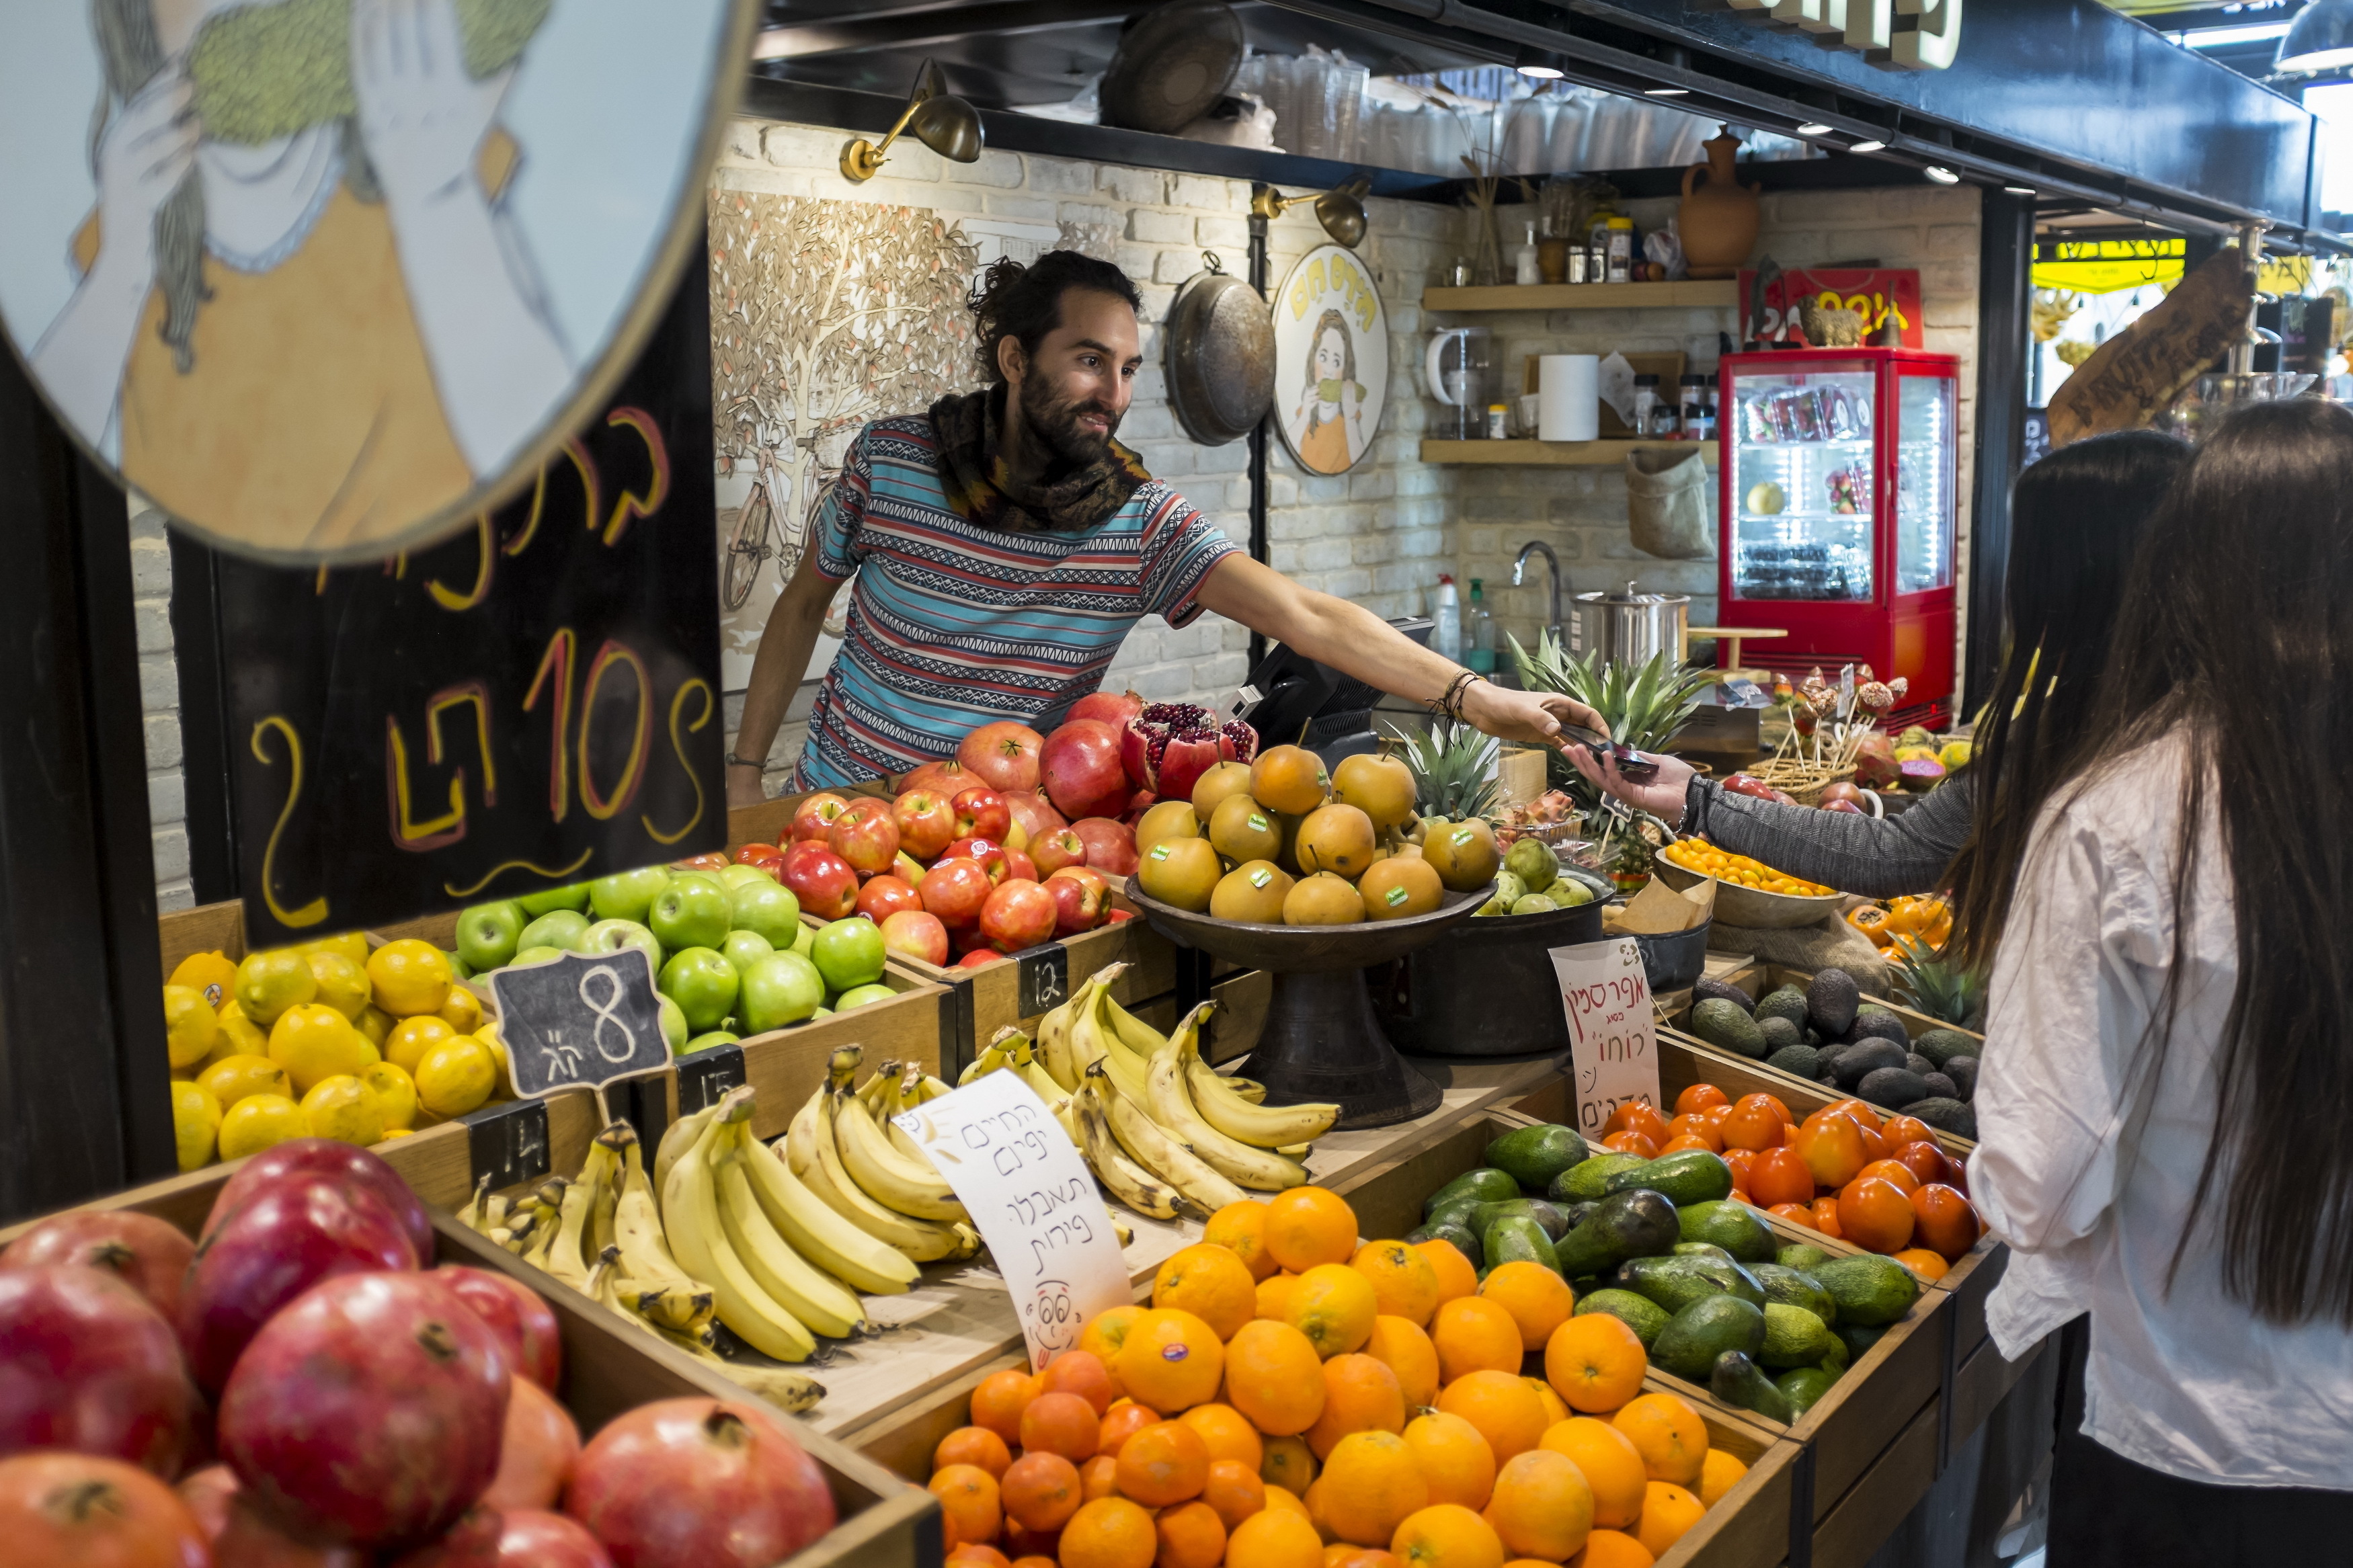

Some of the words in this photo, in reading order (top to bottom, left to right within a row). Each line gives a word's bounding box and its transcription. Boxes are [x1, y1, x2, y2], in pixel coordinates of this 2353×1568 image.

[1035, 962, 1062, 1005] 12
[579, 964, 636, 1063] 8
[961, 1104, 1037, 1149] החיים
[993, 1130, 1047, 1177] יפים
[1031, 1214, 1093, 1276] פירות
